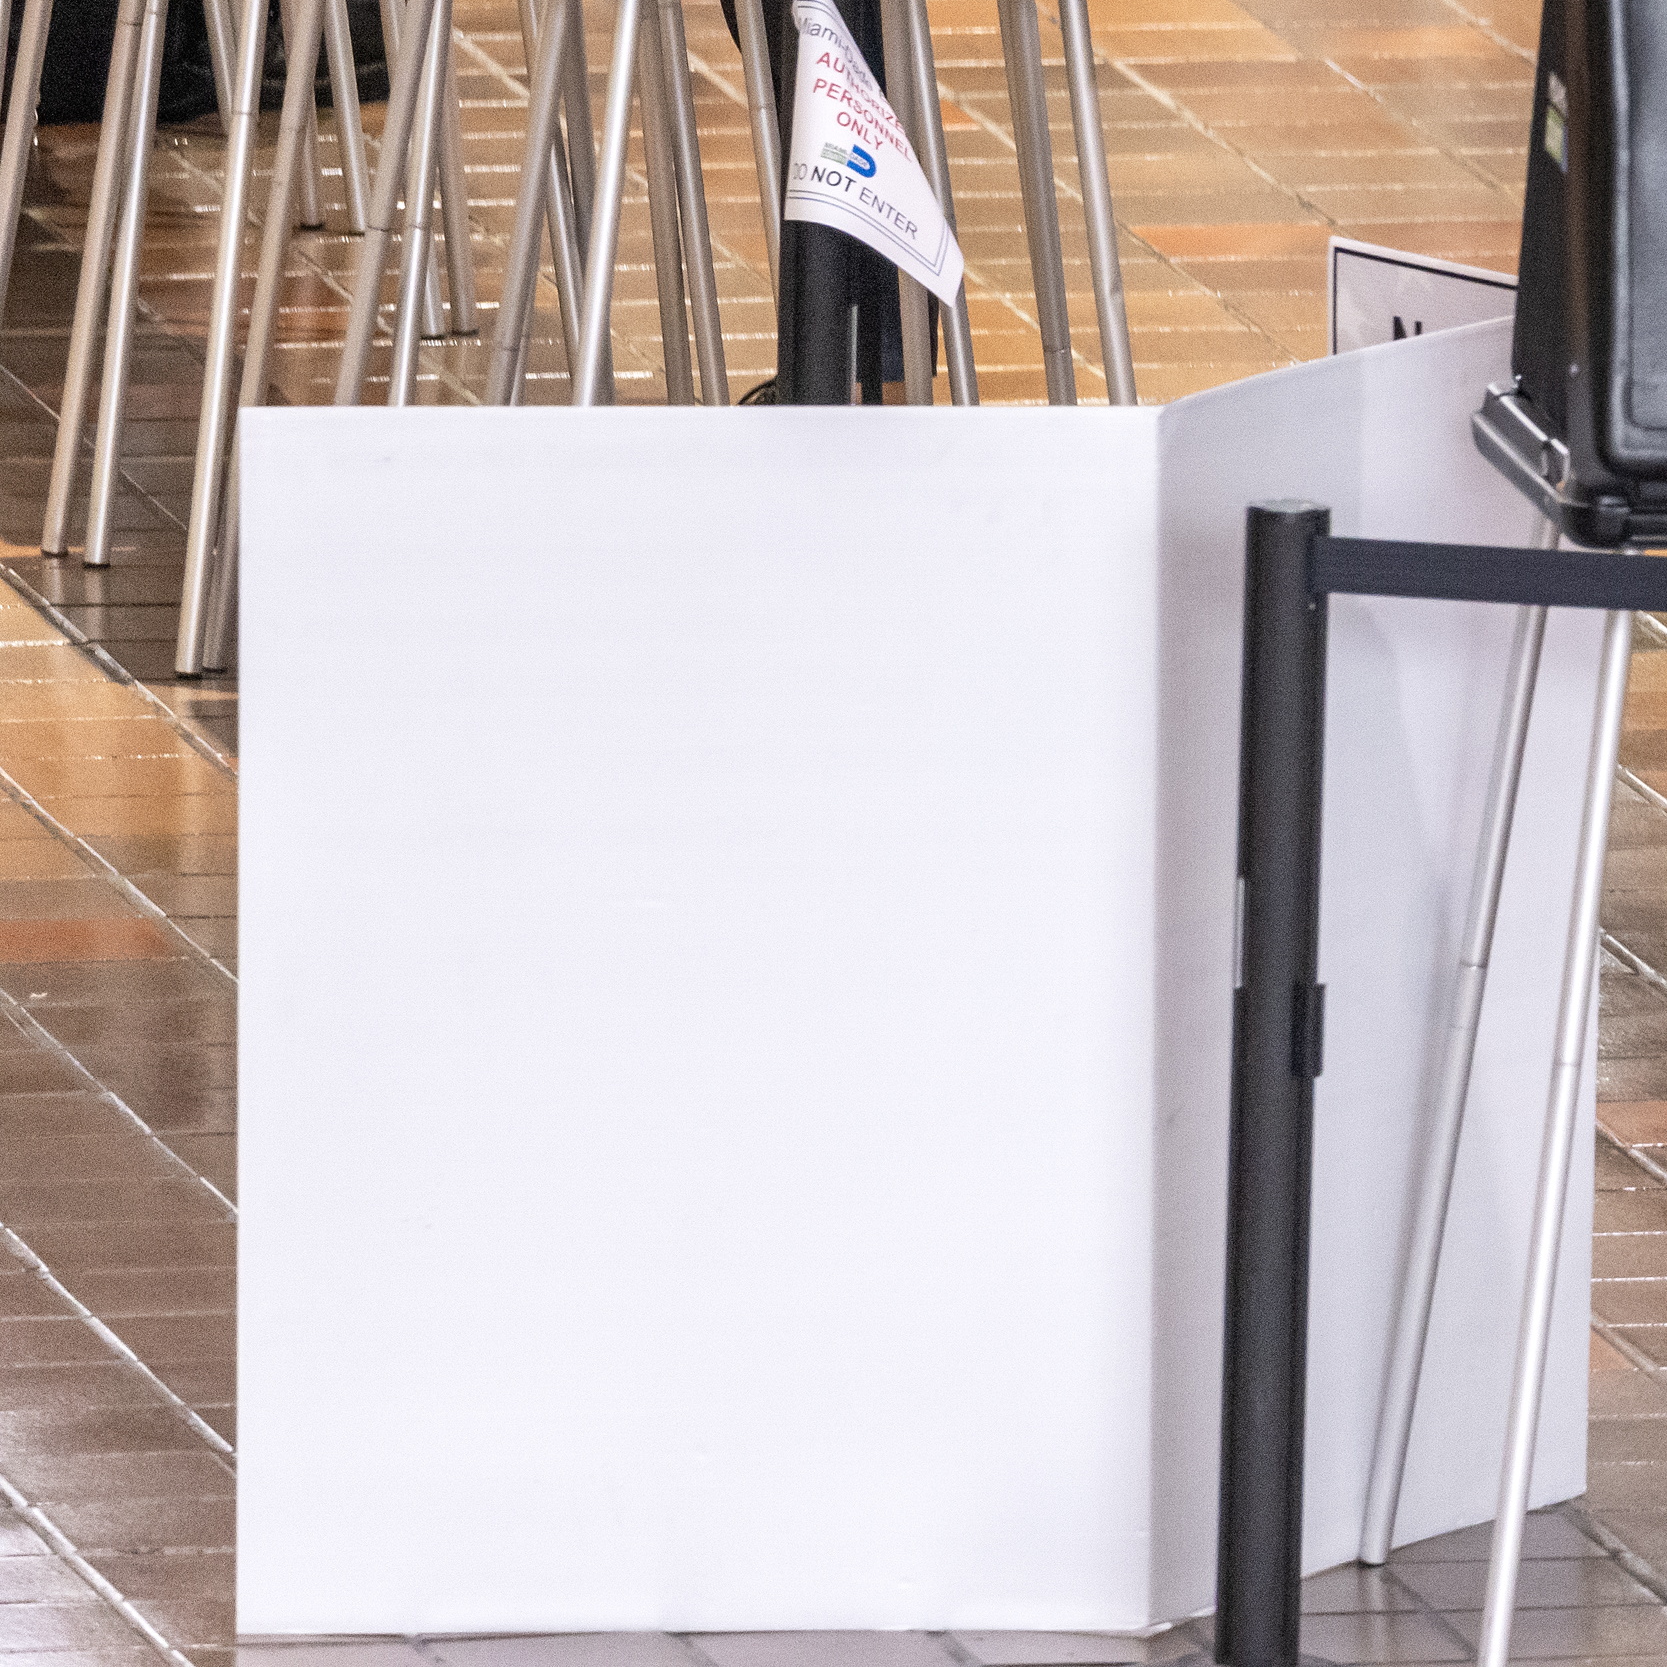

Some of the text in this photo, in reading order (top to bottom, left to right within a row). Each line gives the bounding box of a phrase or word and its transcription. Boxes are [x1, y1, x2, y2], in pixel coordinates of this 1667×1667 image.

[812, 78, 913, 163] PERSONNEL
[816, 52, 905, 135] AUTHORIZE
[836, 111, 884, 151] ONLY
[810, 166, 857, 192] NOT
[859, 186, 919, 239] ENTER
